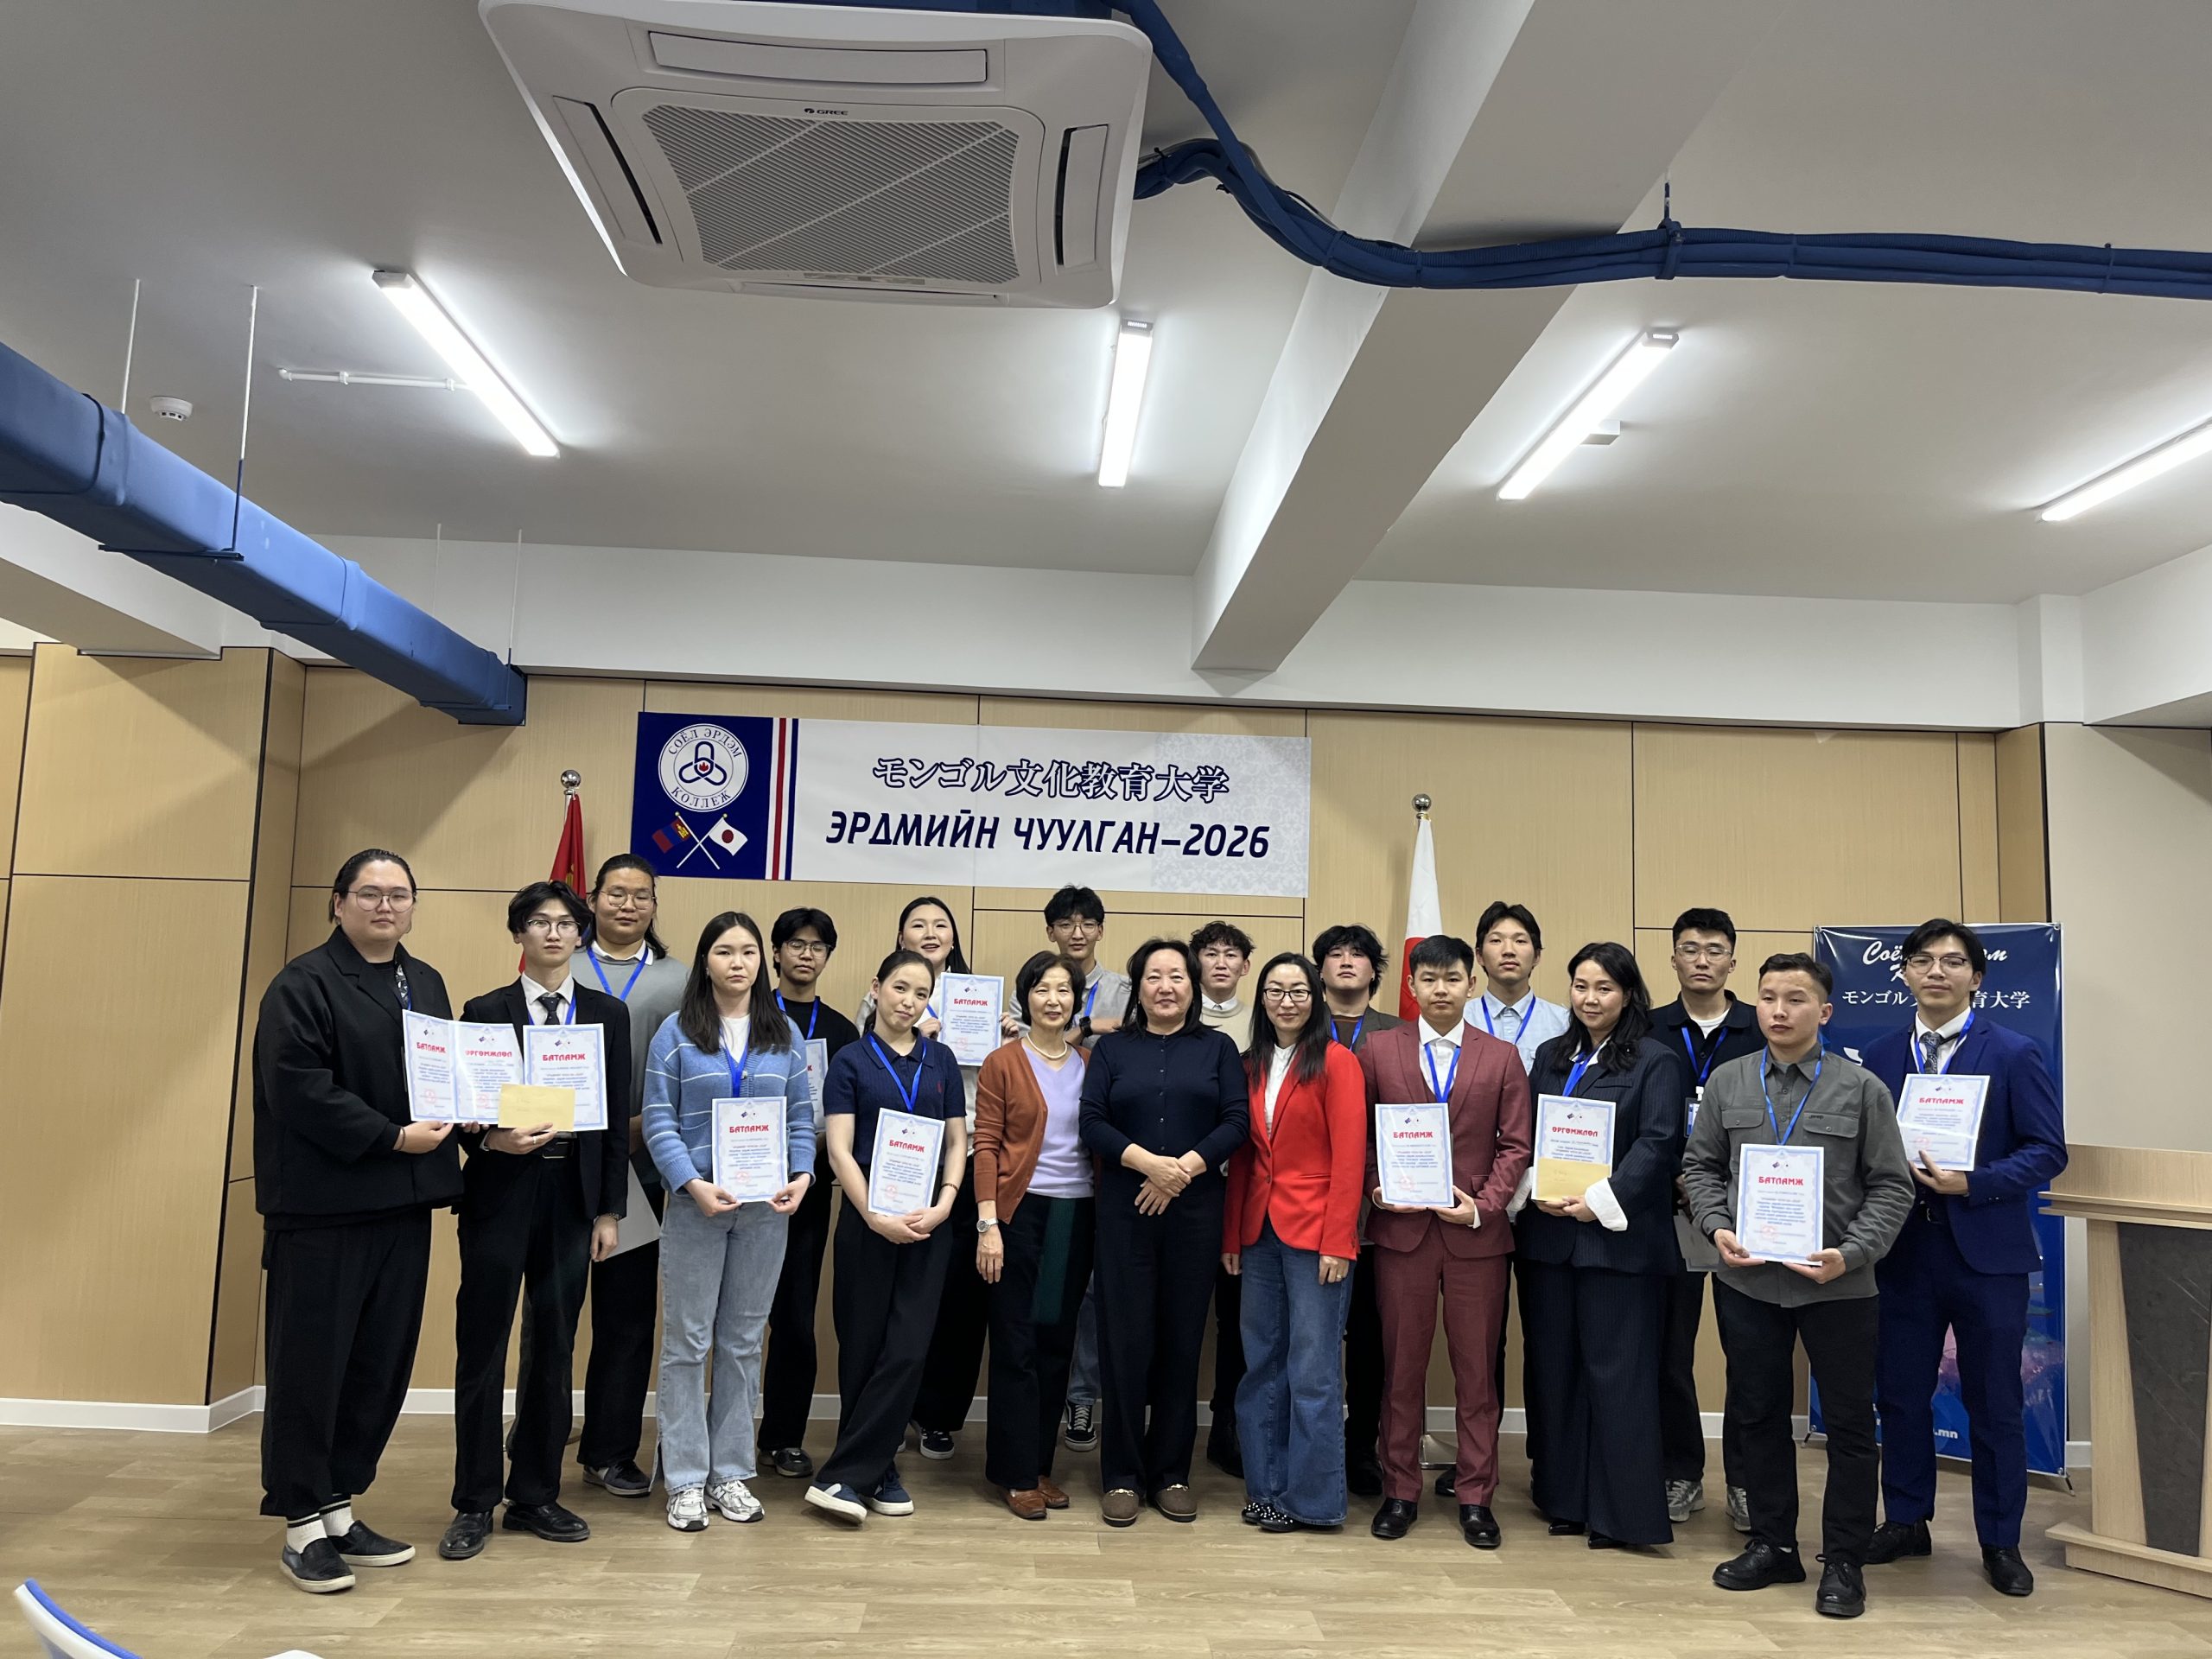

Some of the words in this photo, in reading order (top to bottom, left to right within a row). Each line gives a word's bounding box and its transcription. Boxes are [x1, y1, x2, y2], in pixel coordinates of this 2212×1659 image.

[668, 728, 698, 755] СОЁЛ
[703, 728, 742, 758] ЭРДЭМ
[872, 757, 1230, 804] モンゴル文化教育大学
[671, 786, 732, 809] КОЛЛЕЖ
[825, 809, 1000, 849] ЭРДМИЙН
[1862, 940, 1904, 965] Соё
[953, 998, 988, 1007] БАТЛАМЖ
[728, 1124, 769, 1134] БАТЛАМЖ
[889, 1140, 925, 1153] БАТЛАМЖ
[1758, 1176, 1804, 1185] БАТЛАМЖ
